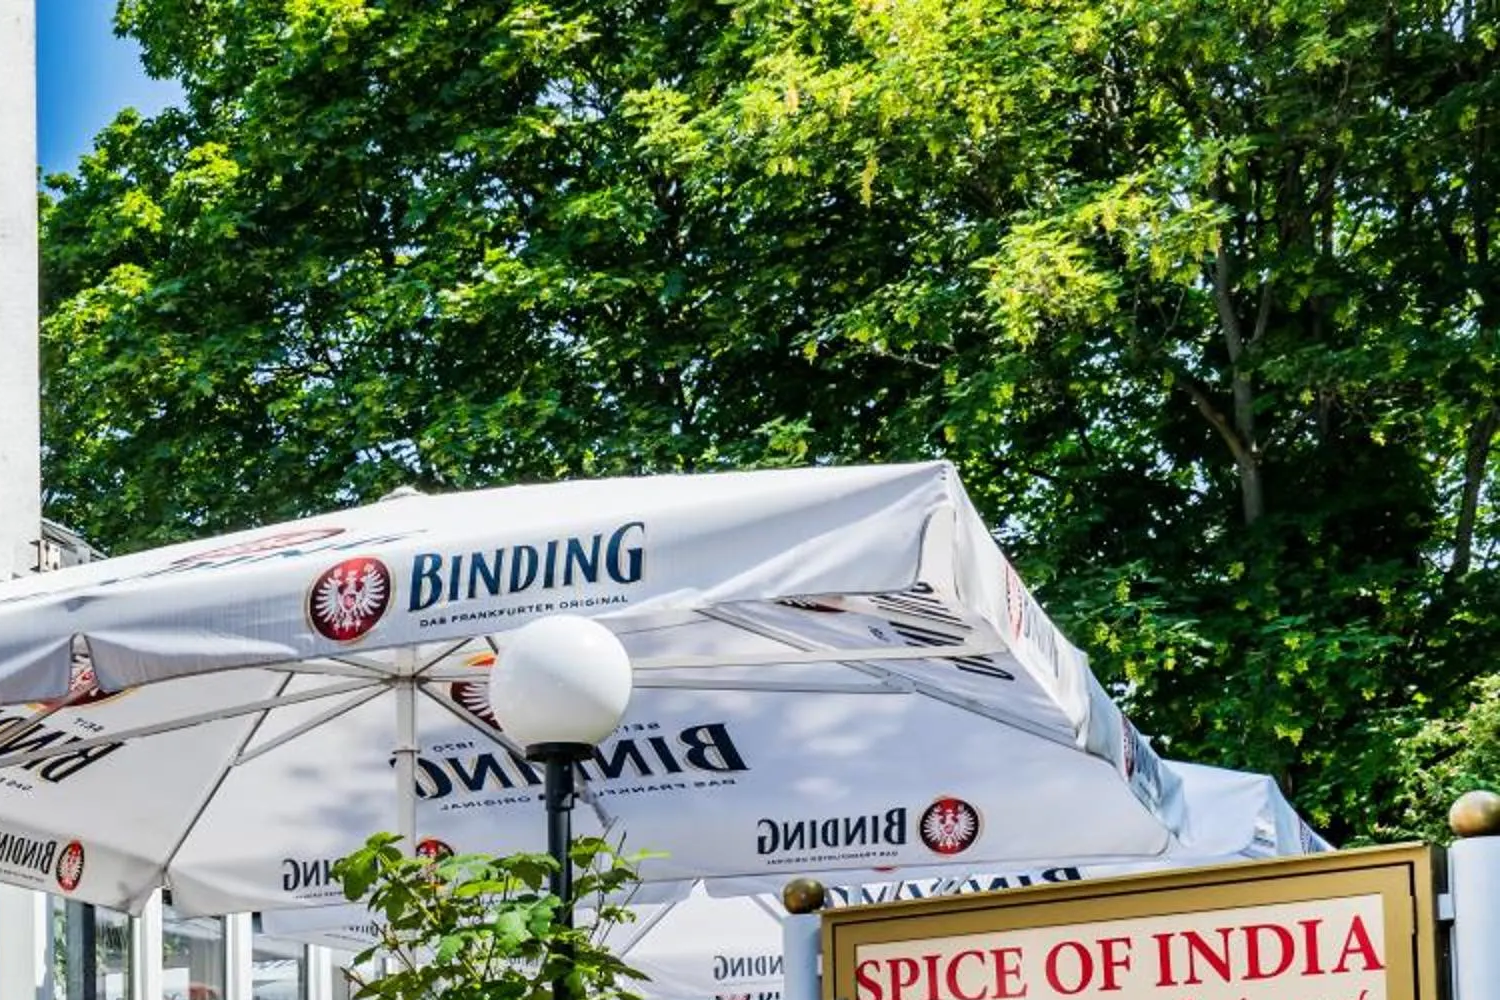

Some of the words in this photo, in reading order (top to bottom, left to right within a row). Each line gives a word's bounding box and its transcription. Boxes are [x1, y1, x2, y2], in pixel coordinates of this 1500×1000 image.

[408, 521, 646, 612] BINDING
[420, 617, 447, 628] DAS
[451, 603, 556, 623] FRANKFURTER
[560, 595, 629, 609] ORIGINAL
[1045, 937, 1133, 995] OF
[1151, 914, 1387, 987] INDIA
